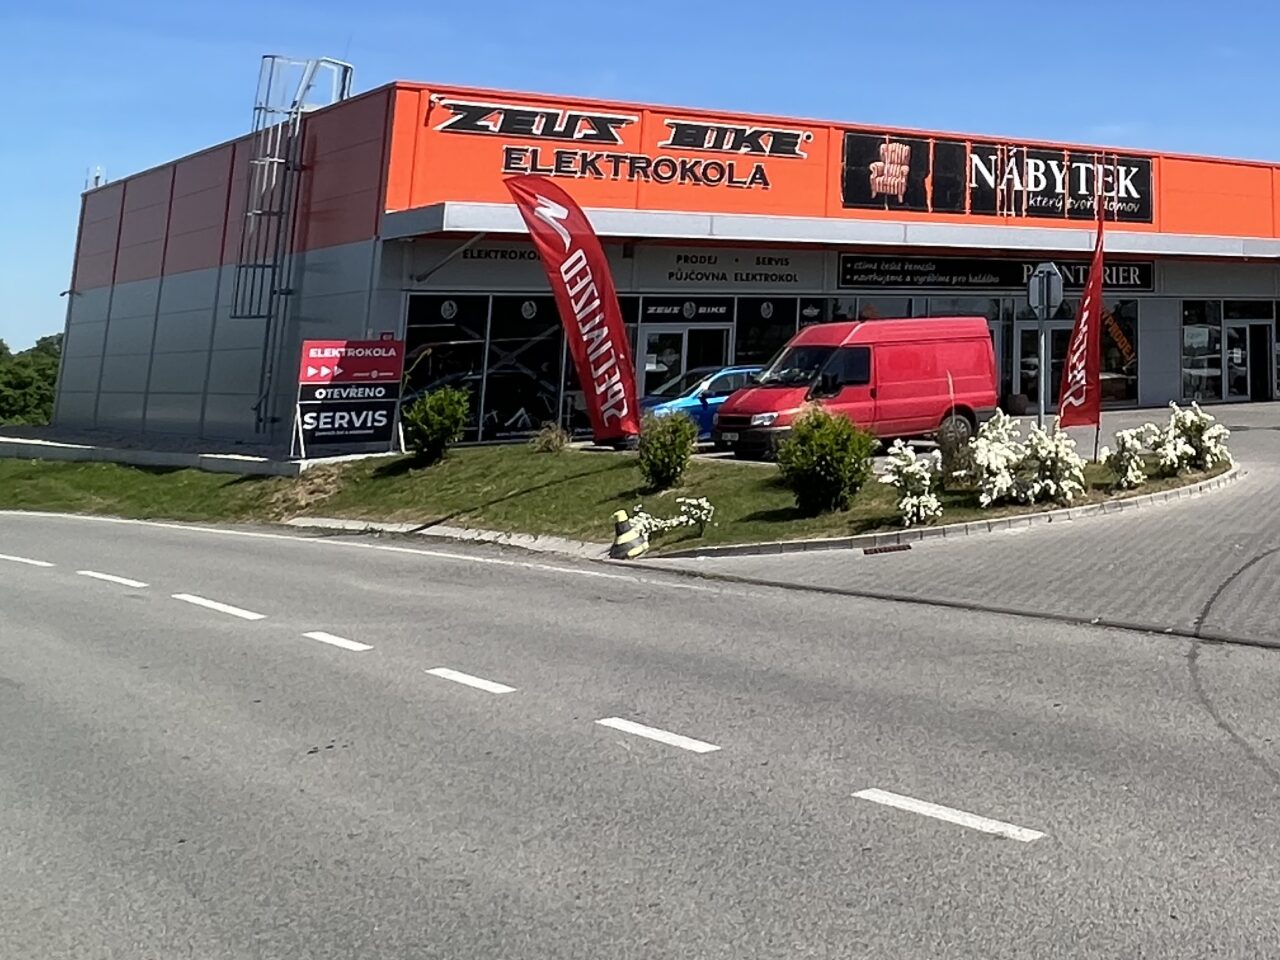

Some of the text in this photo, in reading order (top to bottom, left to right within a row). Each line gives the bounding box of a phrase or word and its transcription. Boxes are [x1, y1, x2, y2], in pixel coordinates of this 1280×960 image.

[432, 96, 807, 159] ZEUS BIKE
[501, 145, 771, 189] ELEKTROKOLA
[969, 148, 1140, 198] NÁBYTEK
[1029, 192, 1063, 211] který
[462, 249, 542, 261] ELEKTROKO
[676, 254, 790, 266] PRODEJ SERVIS
[668, 268, 799, 283] PŮJČOVNA ELEKTROKOL
[309, 347, 397, 358] ELEKTROKOLA
[314, 385, 386, 399] OTEVŘENO
[303, 410, 388, 430] SERVIS
